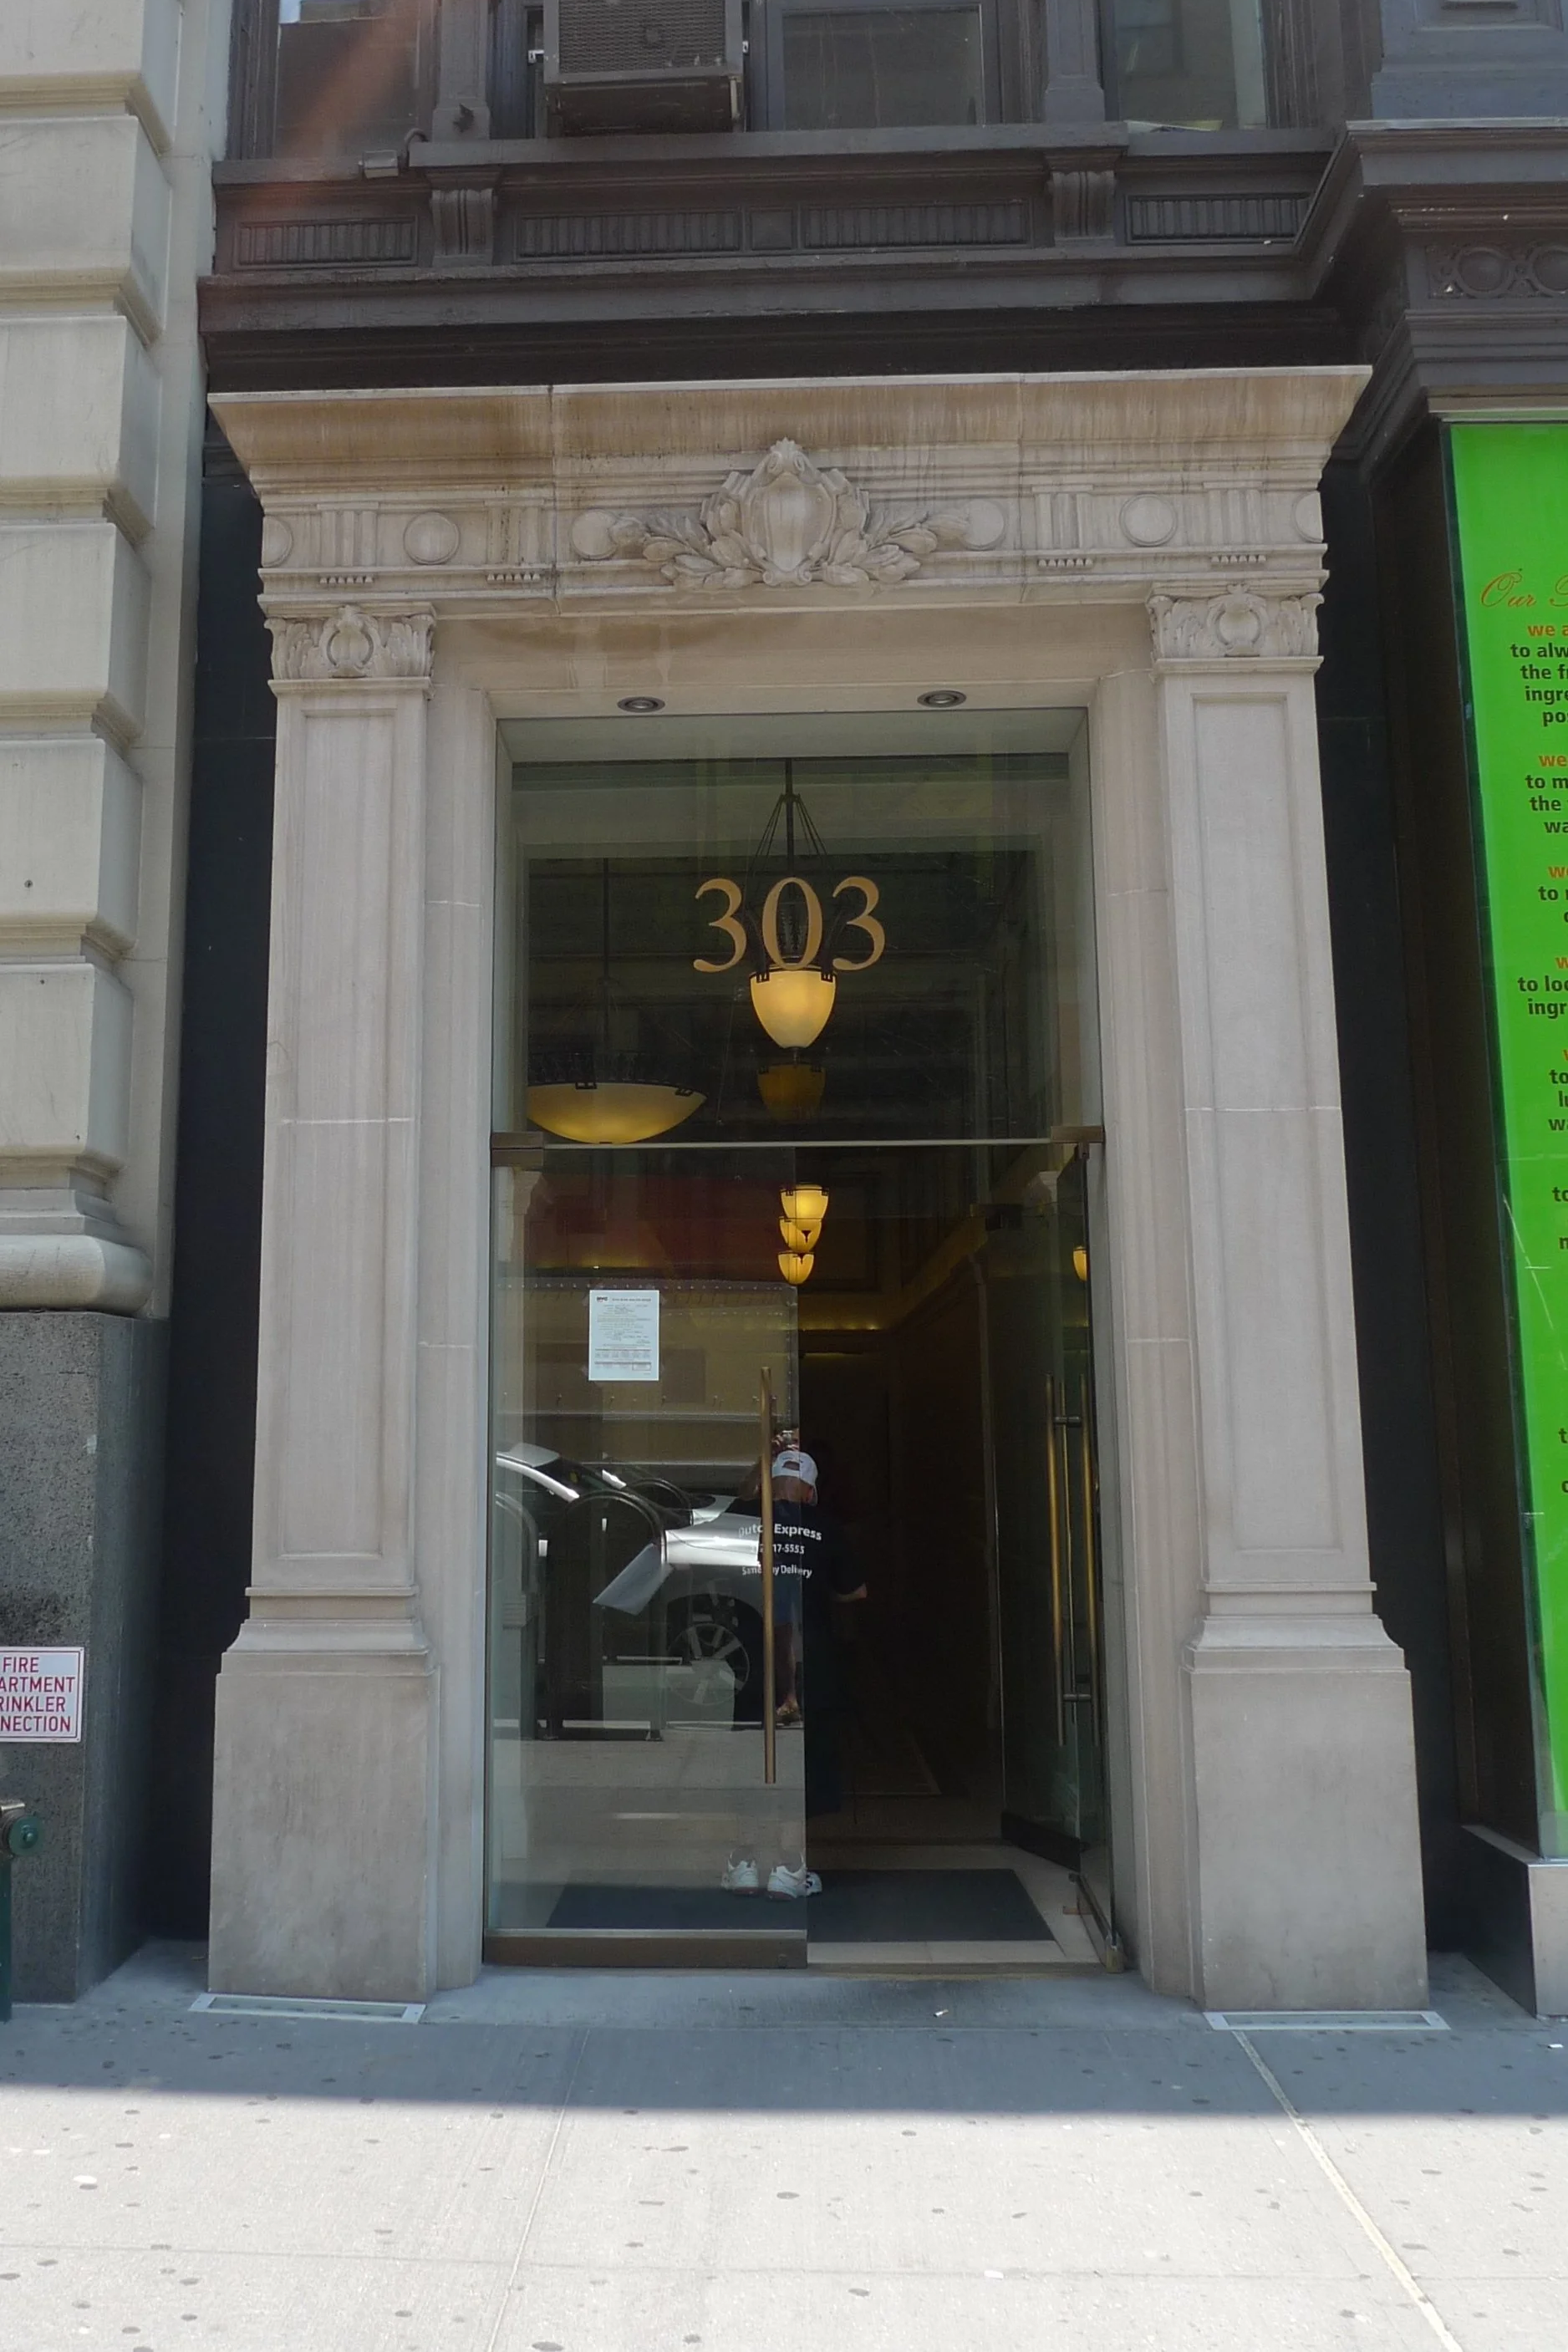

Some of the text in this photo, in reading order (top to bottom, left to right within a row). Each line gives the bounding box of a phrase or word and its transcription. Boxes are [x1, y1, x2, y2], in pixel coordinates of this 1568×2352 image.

[1481, 571, 1536, 607] Our
[1528, 625, 1555, 637] we
[1510, 644, 1530, 658] to
[1520, 664, 1551, 680] the
[1542, 711, 1568, 727] po
[1539, 755, 1568, 767] we
[1525, 775, 1545, 789] to
[1529, 795, 1561, 812] the
[1538, 886, 1559, 901] to
[692, 875, 886, 973] 303
[1517, 976, 1539, 992] to
[774, 1523, 822, 1541] Express
[3, 1657, 39, 1672] FIRE
[0, 1677, 75, 1693] ARTMENT
[0, 1716, 70, 1733] NECTION
